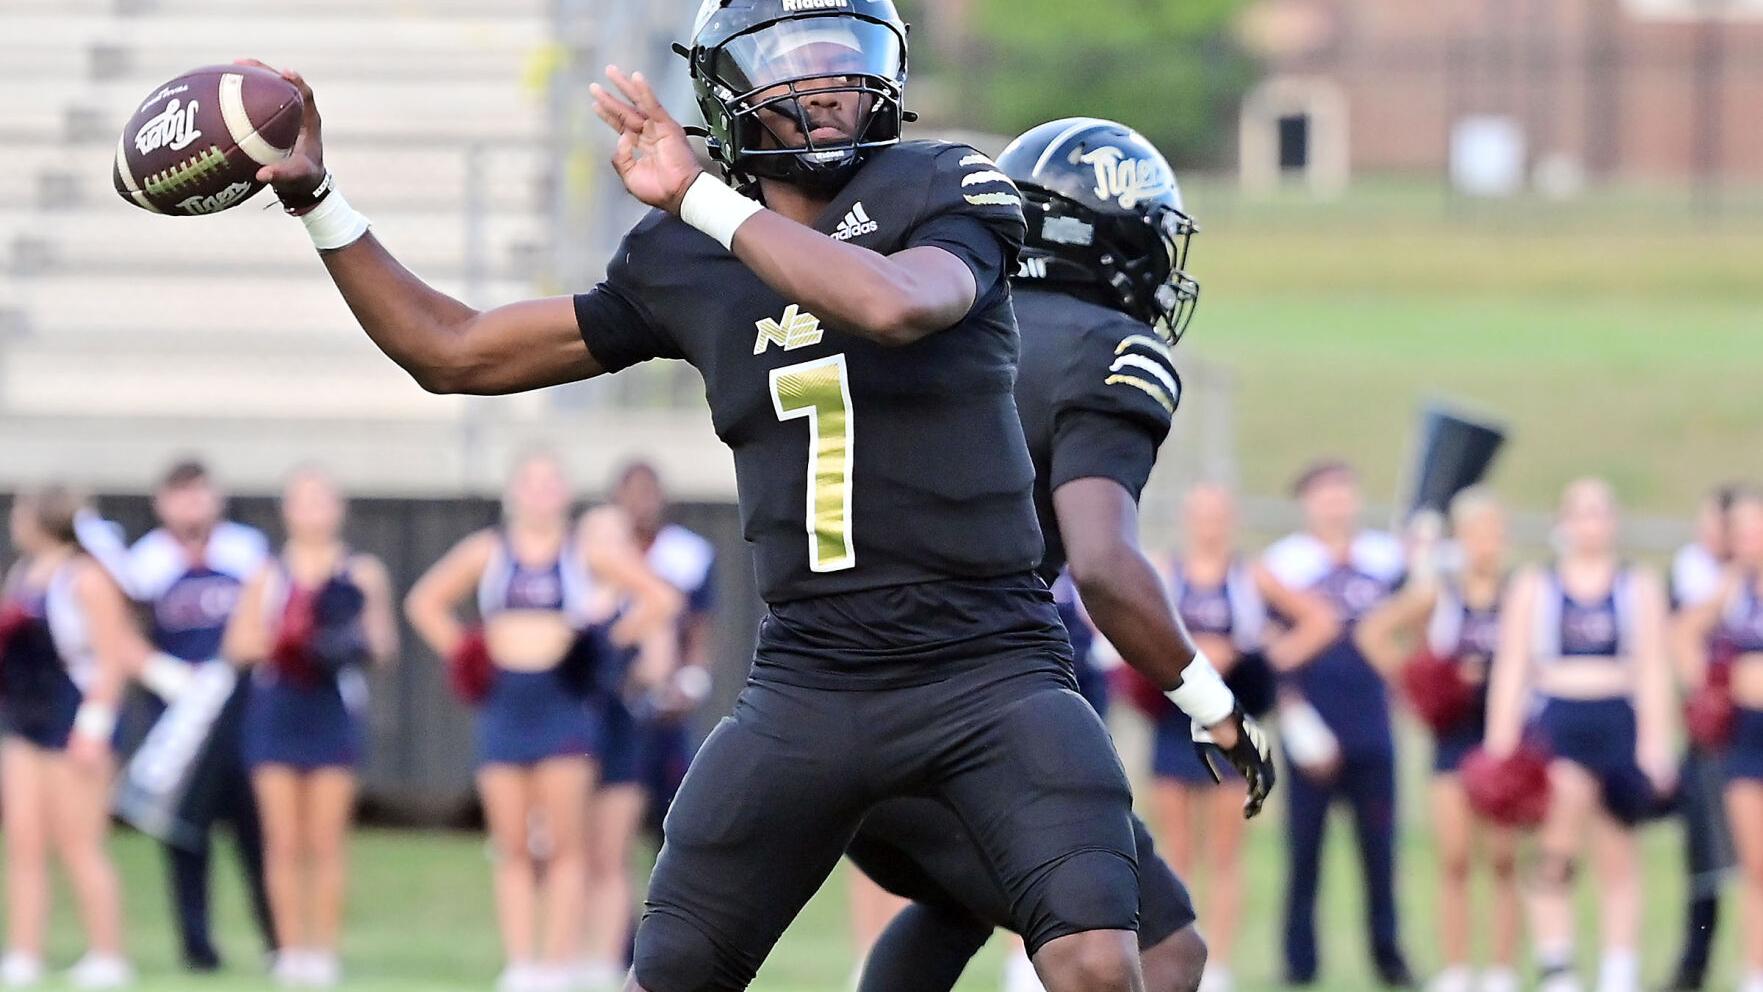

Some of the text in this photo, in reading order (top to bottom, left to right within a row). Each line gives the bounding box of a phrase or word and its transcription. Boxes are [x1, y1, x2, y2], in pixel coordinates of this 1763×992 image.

[135, 99, 202, 156] Tigers
[830, 220, 878, 241] adidas
[753, 303, 825, 356] NE
